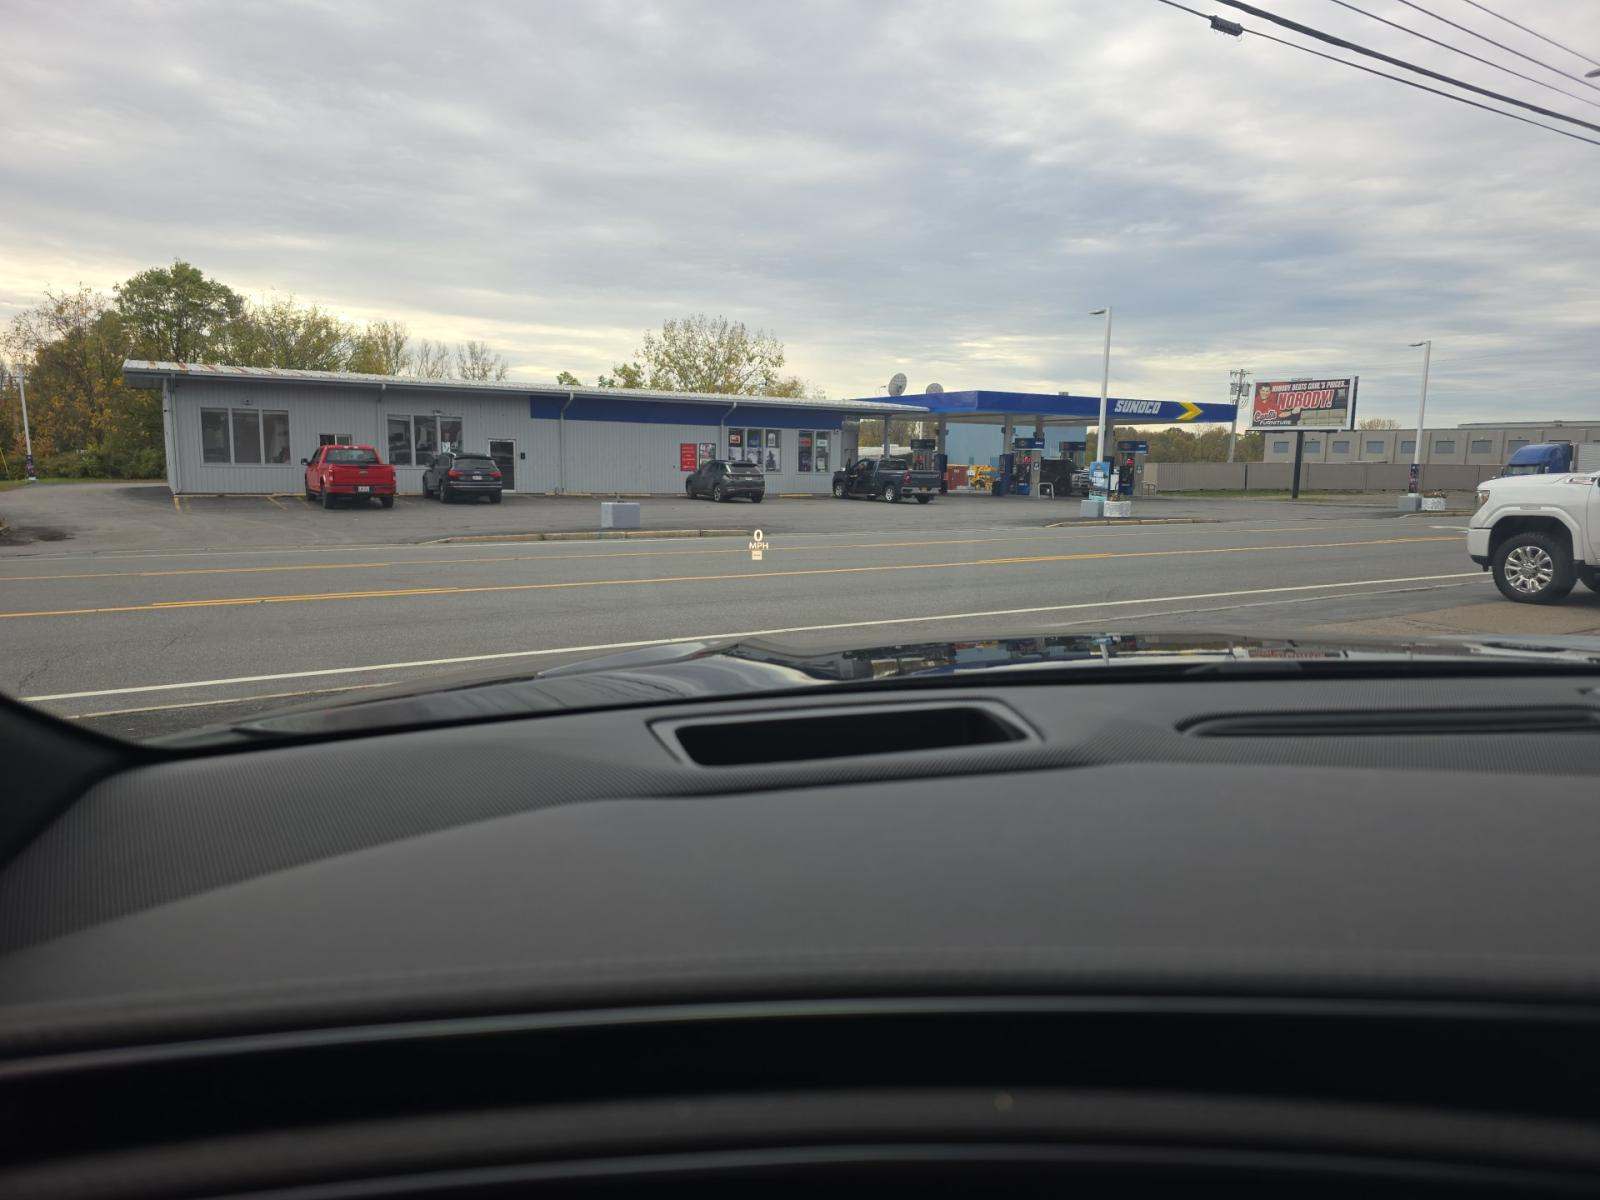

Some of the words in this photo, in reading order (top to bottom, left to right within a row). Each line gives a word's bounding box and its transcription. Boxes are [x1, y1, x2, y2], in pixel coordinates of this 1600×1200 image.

[1277, 389, 1335, 410] NOBODY!
[1114, 400, 1161, 415] SUNOCO
[754, 529, 763, 541] 0
[749, 541, 769, 550] MPH
